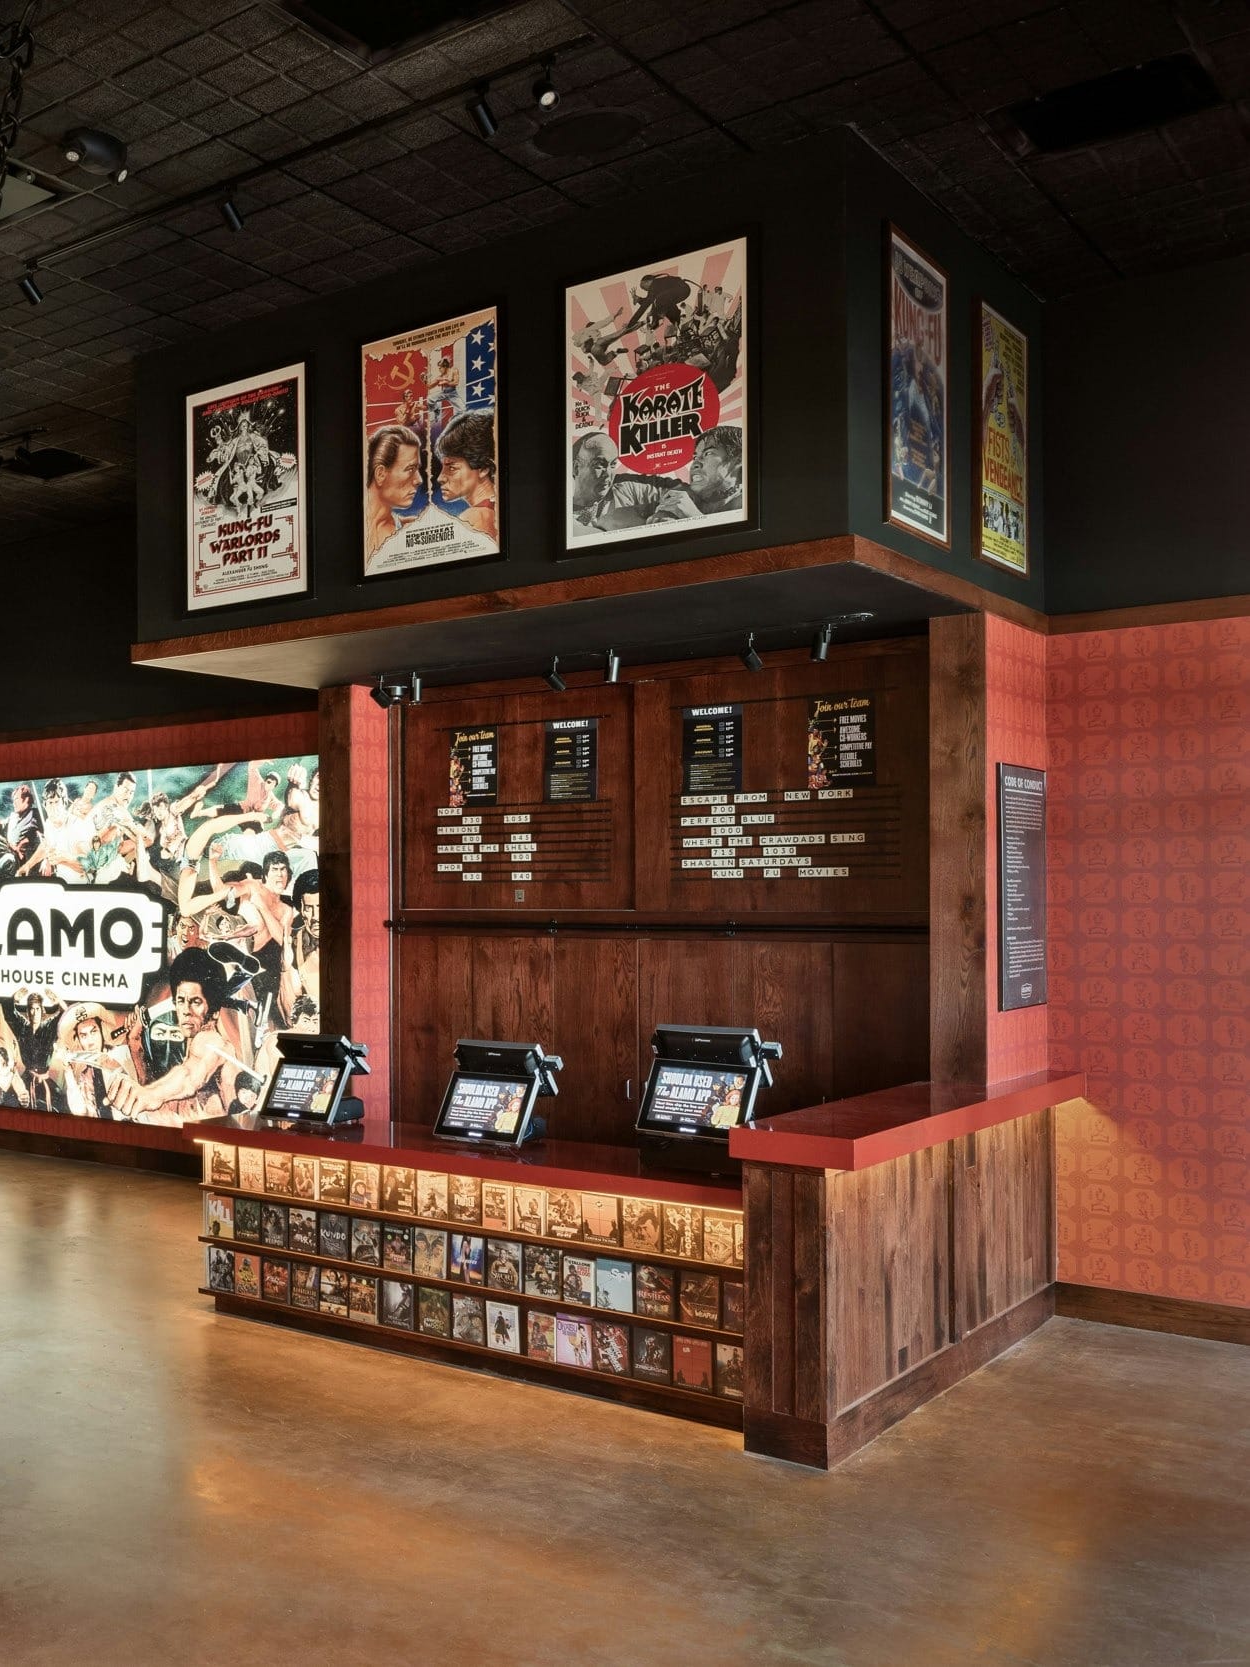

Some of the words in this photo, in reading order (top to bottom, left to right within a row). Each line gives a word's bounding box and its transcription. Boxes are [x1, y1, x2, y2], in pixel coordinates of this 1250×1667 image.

[654, 383, 671, 392] THE
[620, 373, 706, 424] KARATE
[619, 412, 704, 457] KILLER
[667, 449, 683, 457] DEATH
[218, 514, 273, 538] KUNG-FU
[209, 529, 281, 554] WARLORDS
[421, 531, 455, 546] SURRENDER
[223, 548, 255, 567] PART
[257, 545, 269, 559] II
[692, 706, 733, 717] WELCOME!
[553, 720, 589, 729] WELCOME!
[1005, 776, 1017, 788] CODE
[1018, 778, 1024, 789] OF
[1024, 779, 1043, 792] CONDUCT
[683, 795, 726, 804] ESCAPE
[820, 790, 851, 798] YORK
[683, 816, 734, 825] PERFECT
[743, 815, 773, 823] BLUE
[438, 826, 479, 834] MINIONS
[684, 838, 721, 846] WHERE
[730, 837, 751, 845] THE
[761, 835, 823, 844] CRAWDADS
[833, 834, 864, 842] SING
[438, 845, 473, 853] MARCEL
[765, 847, 795, 855] 1030
[742, 858, 810, 866] SATURDAYS
[800, 868, 848, 876] MOVIES
[62, 971, 129, 989] CINEMA
[662, 1072, 694, 1087] SHOULDA
[693, 1075, 713, 1089] USED
[484, 1085, 501, 1097] USED
[670, 1087, 696, 1101] ALAMO
[695, 1089, 712, 1102] APP
[463, 1096, 486, 1109] ALAMO
[485, 1097, 498, 1110] APP
[320, 1229, 347, 1241] KUNDO
[637, 1289, 671, 1302] RESTLESS
